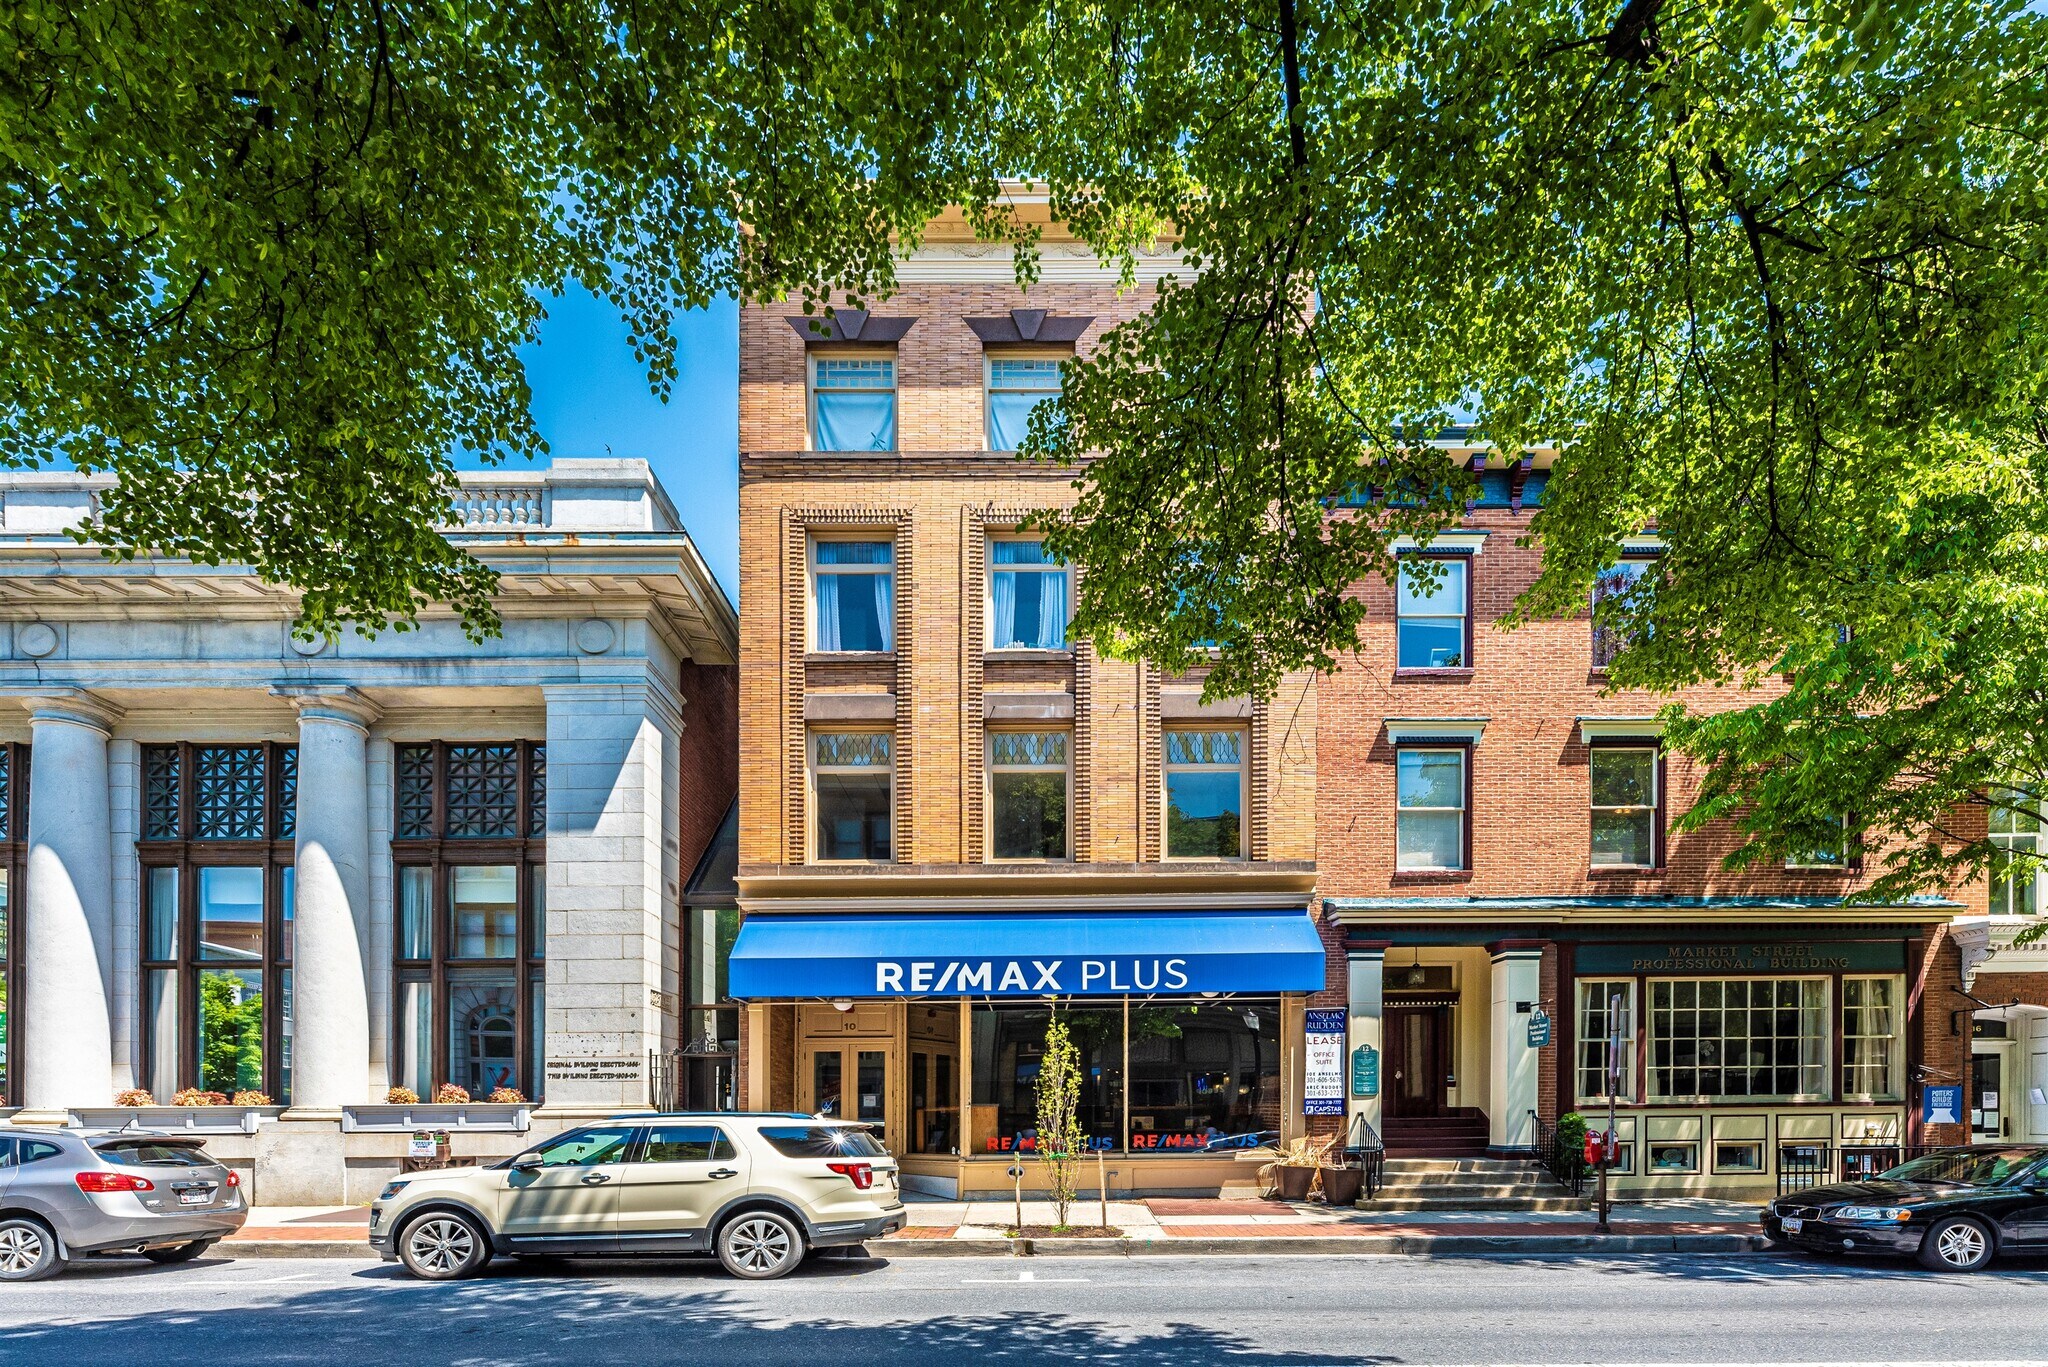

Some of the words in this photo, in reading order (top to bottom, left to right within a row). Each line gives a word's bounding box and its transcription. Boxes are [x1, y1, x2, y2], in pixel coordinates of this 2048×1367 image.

[1667, 946, 1739, 958] MARKET
[1752, 945, 1815, 957] STREET
[1632, 958, 1756, 970] PROFESSIONAL
[1769, 957, 1850, 969] BUILDING
[876, 961, 1063, 992] RE/MAX
[1081, 959, 1188, 990] PLUS
[844, 1023, 856, 1031] 10
[1307, 1036, 1344, 1045] LEASE
[1133, 1134, 1210, 1148] RE/MAX
